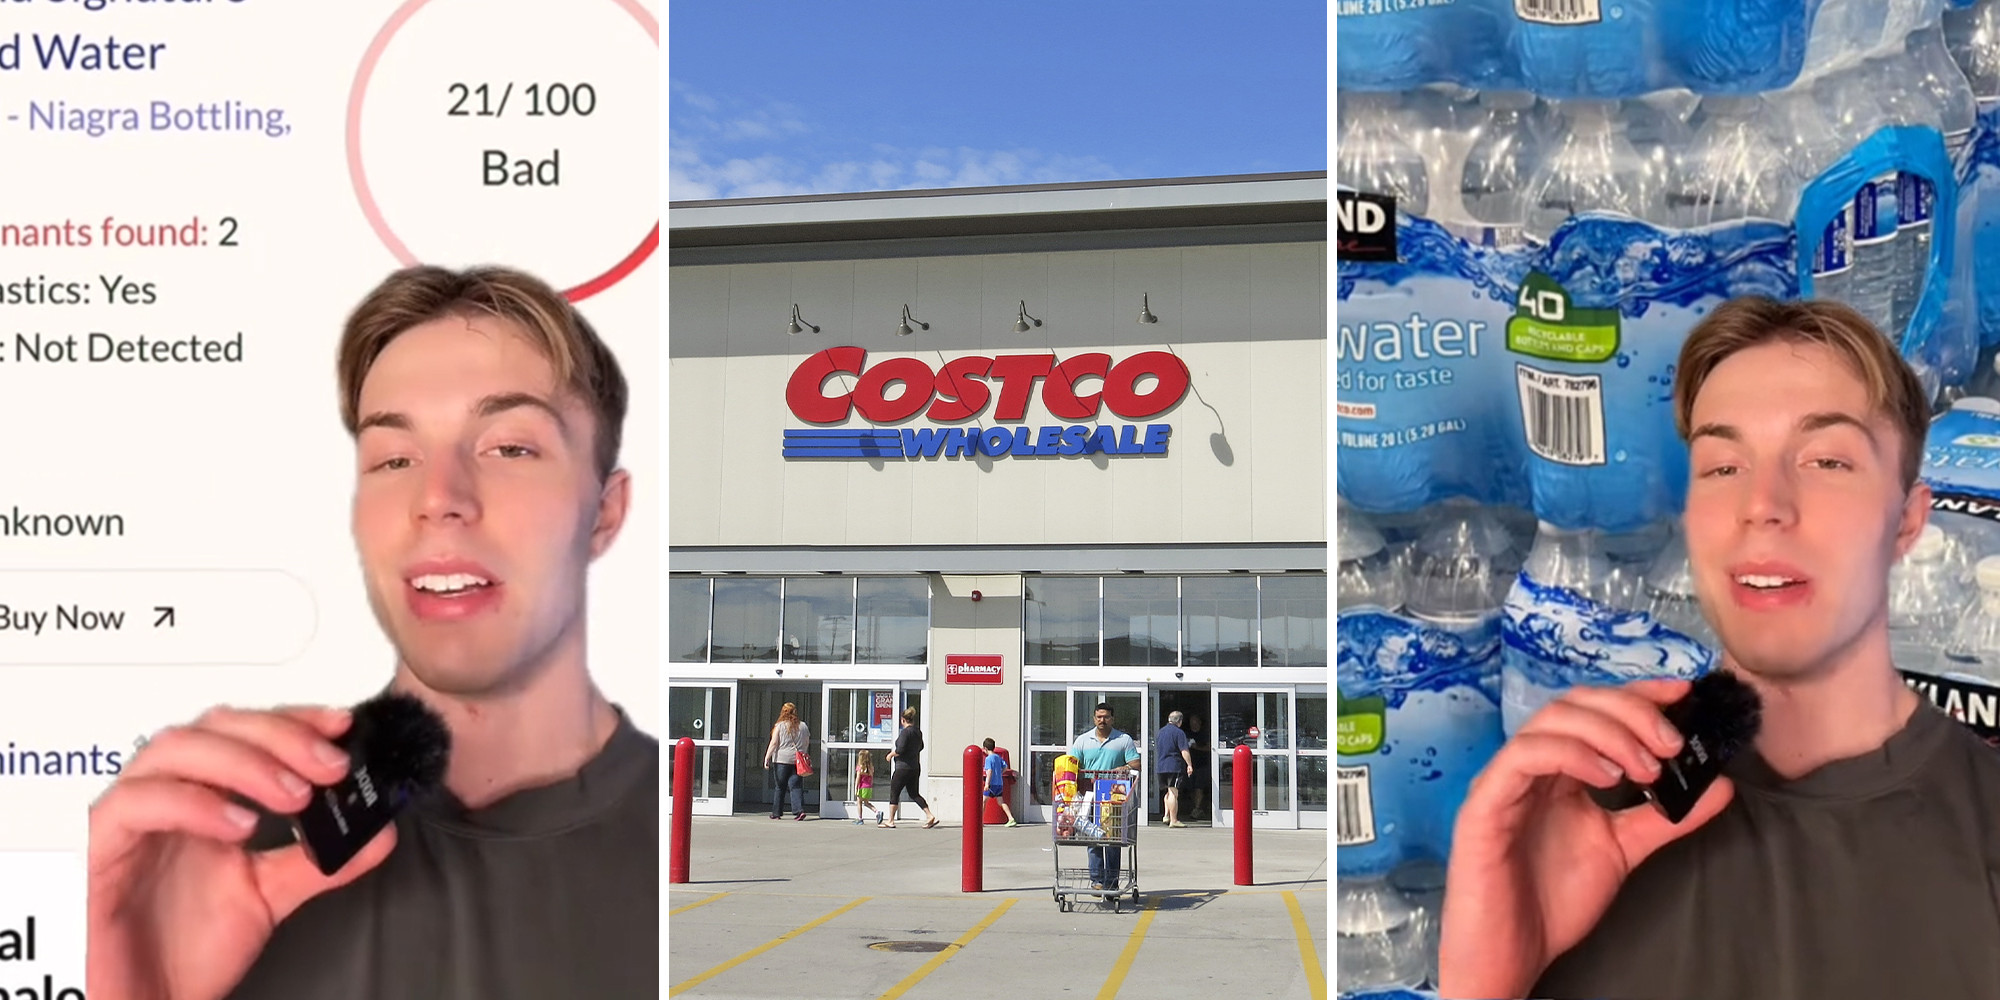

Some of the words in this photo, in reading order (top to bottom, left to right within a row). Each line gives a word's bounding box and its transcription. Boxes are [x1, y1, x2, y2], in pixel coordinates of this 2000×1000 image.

[32, 33, 166, 70] Water
[448, 82, 514, 118] 21/
[526, 82, 597, 117] 100
[29, 101, 139, 138] Niagra
[150, 101, 292, 138] Bottling,
[482, 148, 560, 187] Bad
[1, 219, 93, 247] nants
[100, 216, 208, 247] found:
[218, 216, 239, 247] 2
[99, 274, 157, 305] Yes
[1519, 285, 1564, 321] 40
[15, 332, 78, 363] Not
[88, 331, 243, 363] Detected
[1337, 314, 1486, 362] water
[786, 346, 1190, 424] COSTCO
[1358, 371, 1386, 391] for
[1394, 368, 1452, 389] taste
[901, 424, 1171, 458] WHOLESALE
[1381, 431, 1396, 447] 20
[1397, 431, 1404, 445] L
[0, 604, 48, 636] Buy
[56, 604, 125, 631] Now
[0, 741, 123, 776] inants
[0, 915, 35, 962] al
